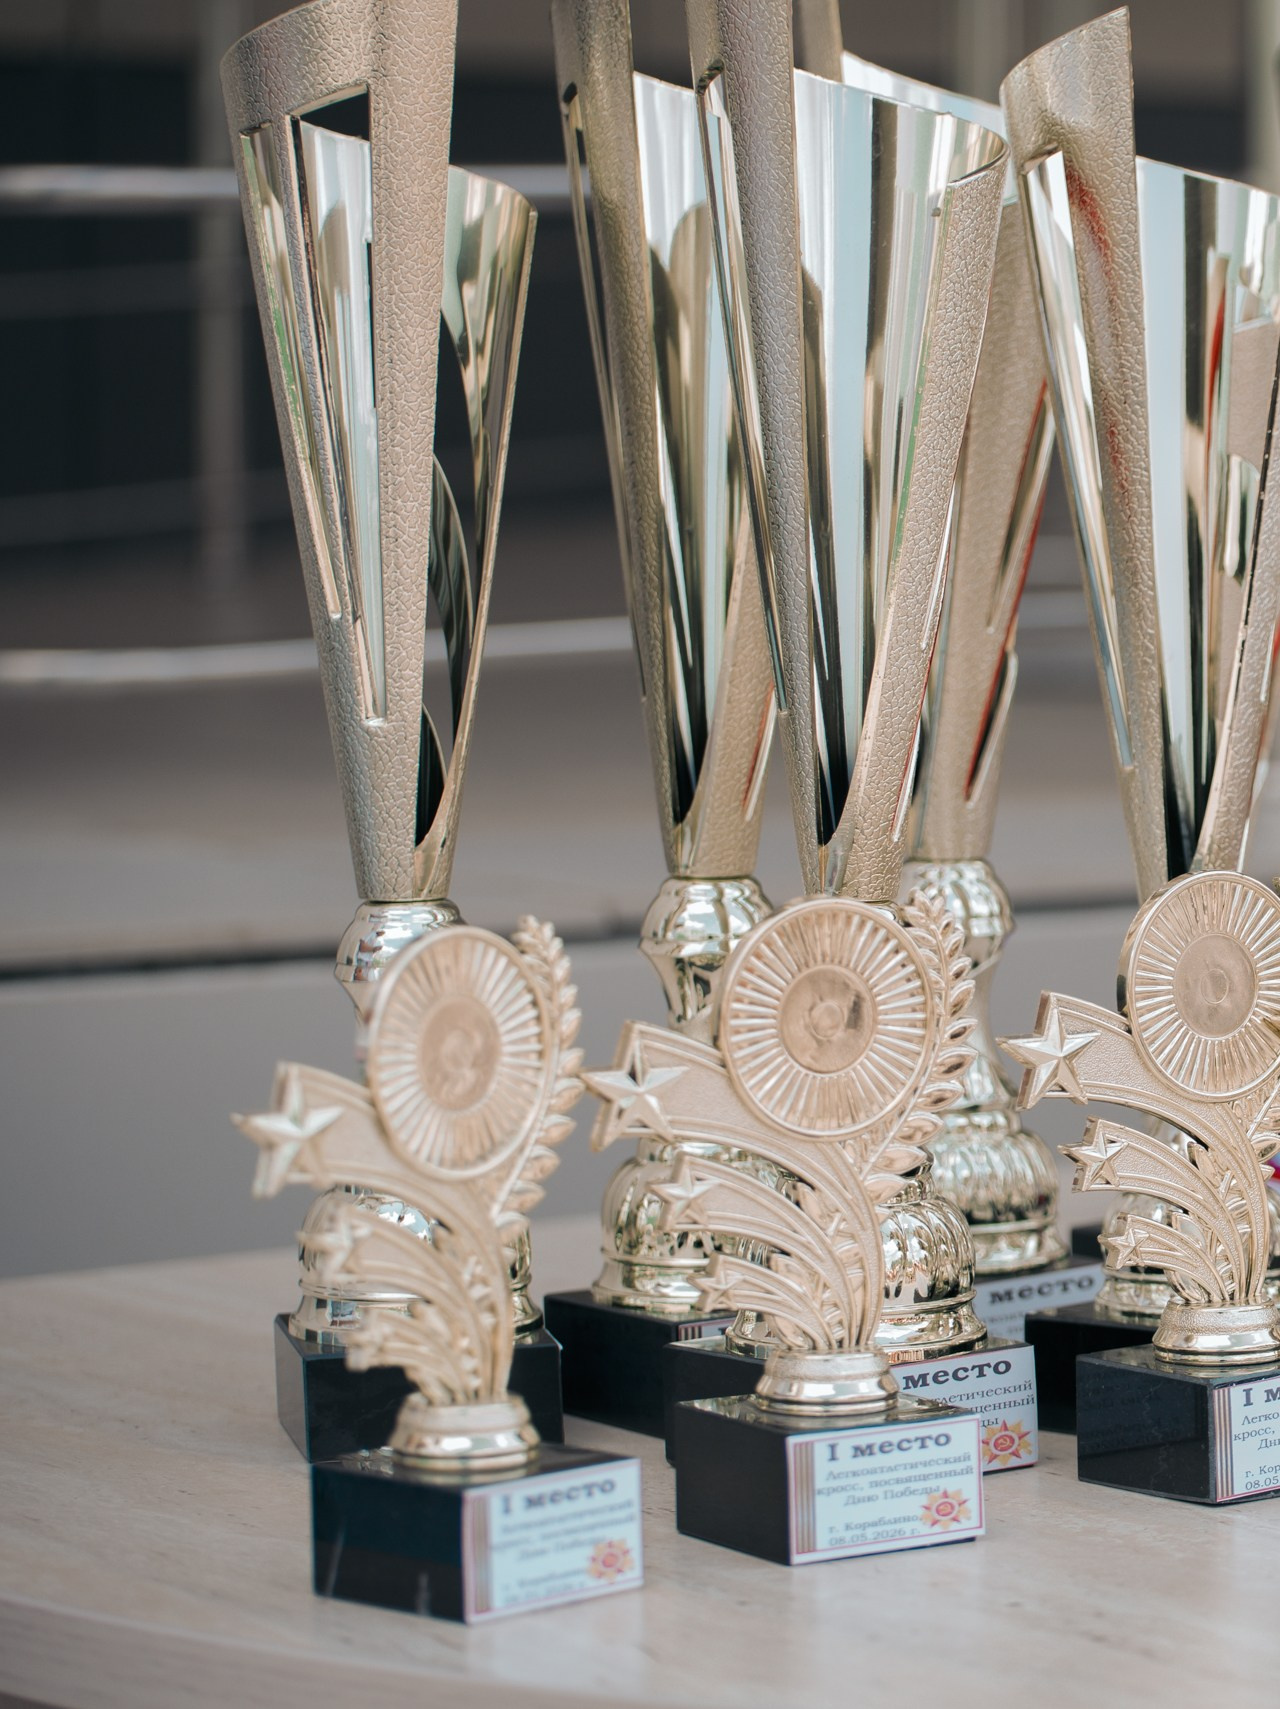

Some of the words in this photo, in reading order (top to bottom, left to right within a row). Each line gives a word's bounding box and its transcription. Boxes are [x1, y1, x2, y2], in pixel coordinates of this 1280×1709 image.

[990, 1276, 1094, 1304] место
[902, 1360, 1012, 1390] место
[936, 1380, 1033, 1405] летический
[970, 1394, 1035, 1413] щенный
[852, 1433, 952, 1459] место
[1233, 1426, 1275, 1442] кросс,
[825, 1452, 972, 1481] Легкоатлетический
[525, 1479, 617, 1510] место
[816, 1481, 864, 1498] кросс,
[869, 1466, 974, 1488] посвященный
[843, 1494, 879, 1507] Дню
[883, 1485, 941, 1501] Победы
[829, 1529, 906, 1547] 08.05.2026
